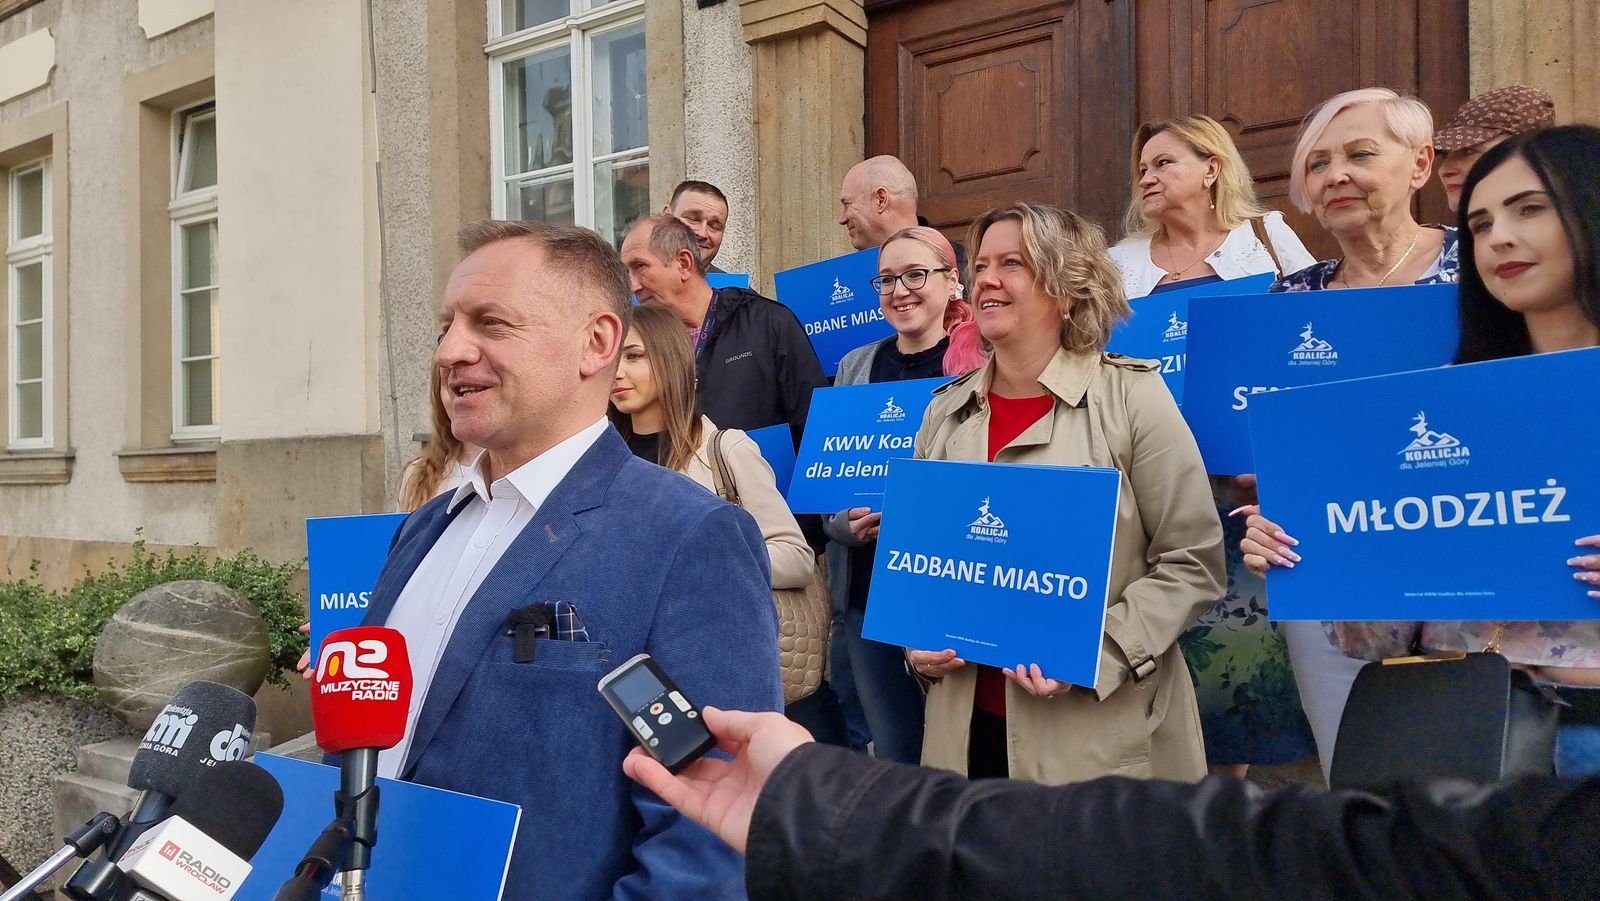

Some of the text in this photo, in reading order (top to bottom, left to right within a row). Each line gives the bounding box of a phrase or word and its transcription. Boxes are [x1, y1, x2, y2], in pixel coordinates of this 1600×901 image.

[804, 307, 885, 336] DBANE MIAS
[1165, 329, 1188, 338] KOALIC
[725, 350, 753, 364] GROUNDS
[1293, 351, 1338, 360] KOALICJA
[823, 434, 875, 452] KWW
[1405, 446, 1470, 462] KOALICJA
[805, 460, 889, 479] dla Jeleni
[1326, 478, 1571, 534] MŁODZIEŻ
[970, 525, 1009, 538] KOALICJA
[887, 550, 1088, 600] ZADBANE MIASTO
[320, 591, 373, 610] MIAS
[320, 680, 400, 694] MUZYCZNE
[352, 690, 399, 701] RADIO
[175, 858, 225, 894] WROCŁAW
[179, 850, 231, 889] RADIO
